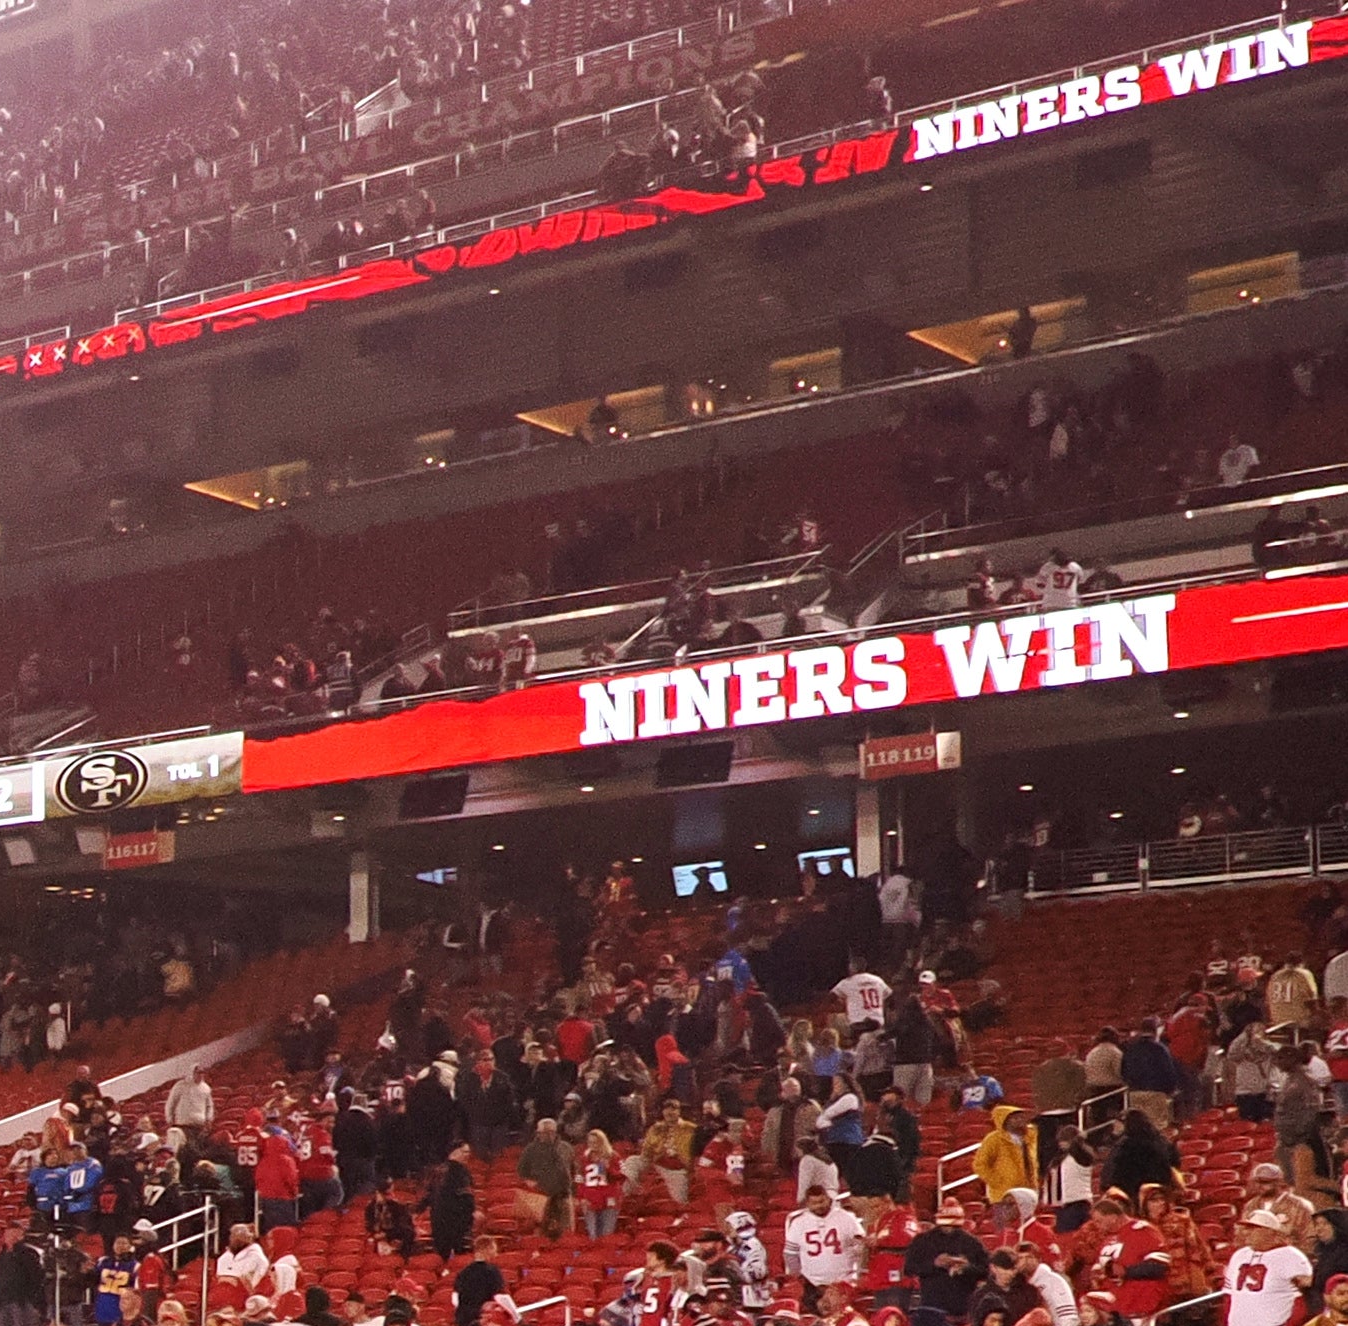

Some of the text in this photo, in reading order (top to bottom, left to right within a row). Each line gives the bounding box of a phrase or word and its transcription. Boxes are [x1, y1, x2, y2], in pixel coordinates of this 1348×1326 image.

[412, 30, 758, 147] CHAMPIONS
[913, 21, 1313, 160] NINERS WIN
[579, 594, 1176, 746] NINERS WIN
[167, 754, 220, 782] TOL 1
[860, 989, 881, 1010] 10
[805, 1228, 843, 1257] 54
[99, 1269, 130, 1294] 52
